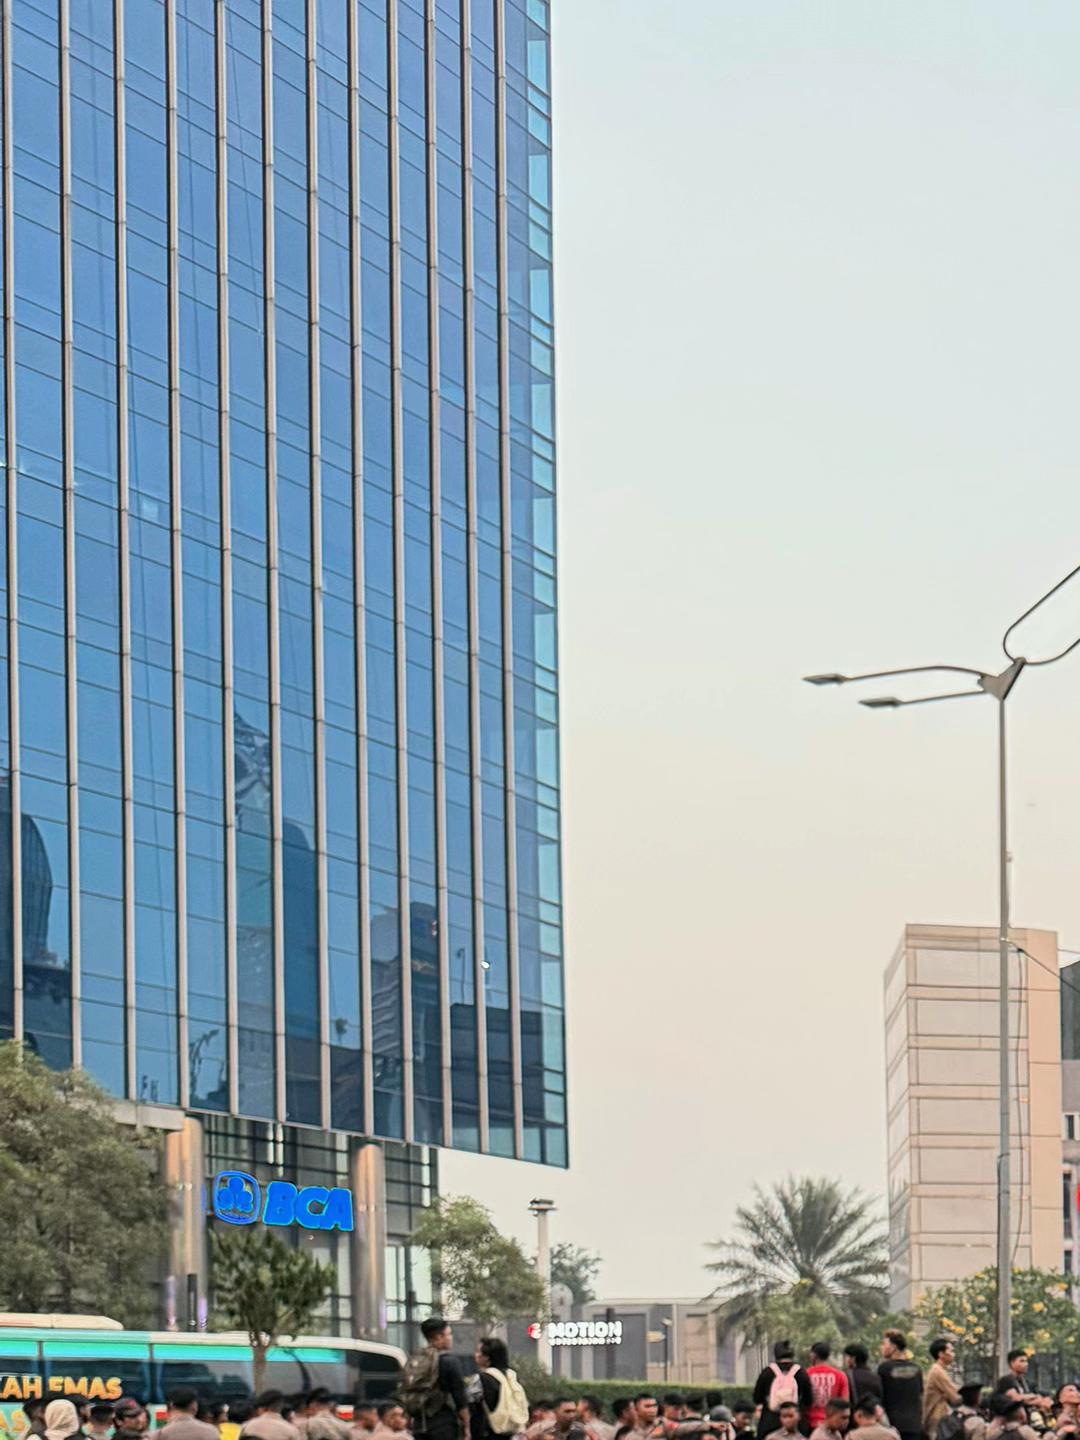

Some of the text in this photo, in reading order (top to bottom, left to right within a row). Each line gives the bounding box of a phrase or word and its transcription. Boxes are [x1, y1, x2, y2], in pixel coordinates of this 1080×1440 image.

[262, 1181, 354, 1231] BCA
[548, 1321, 622, 1338] MOTION
[48, 1375, 122, 1400] EMAS
